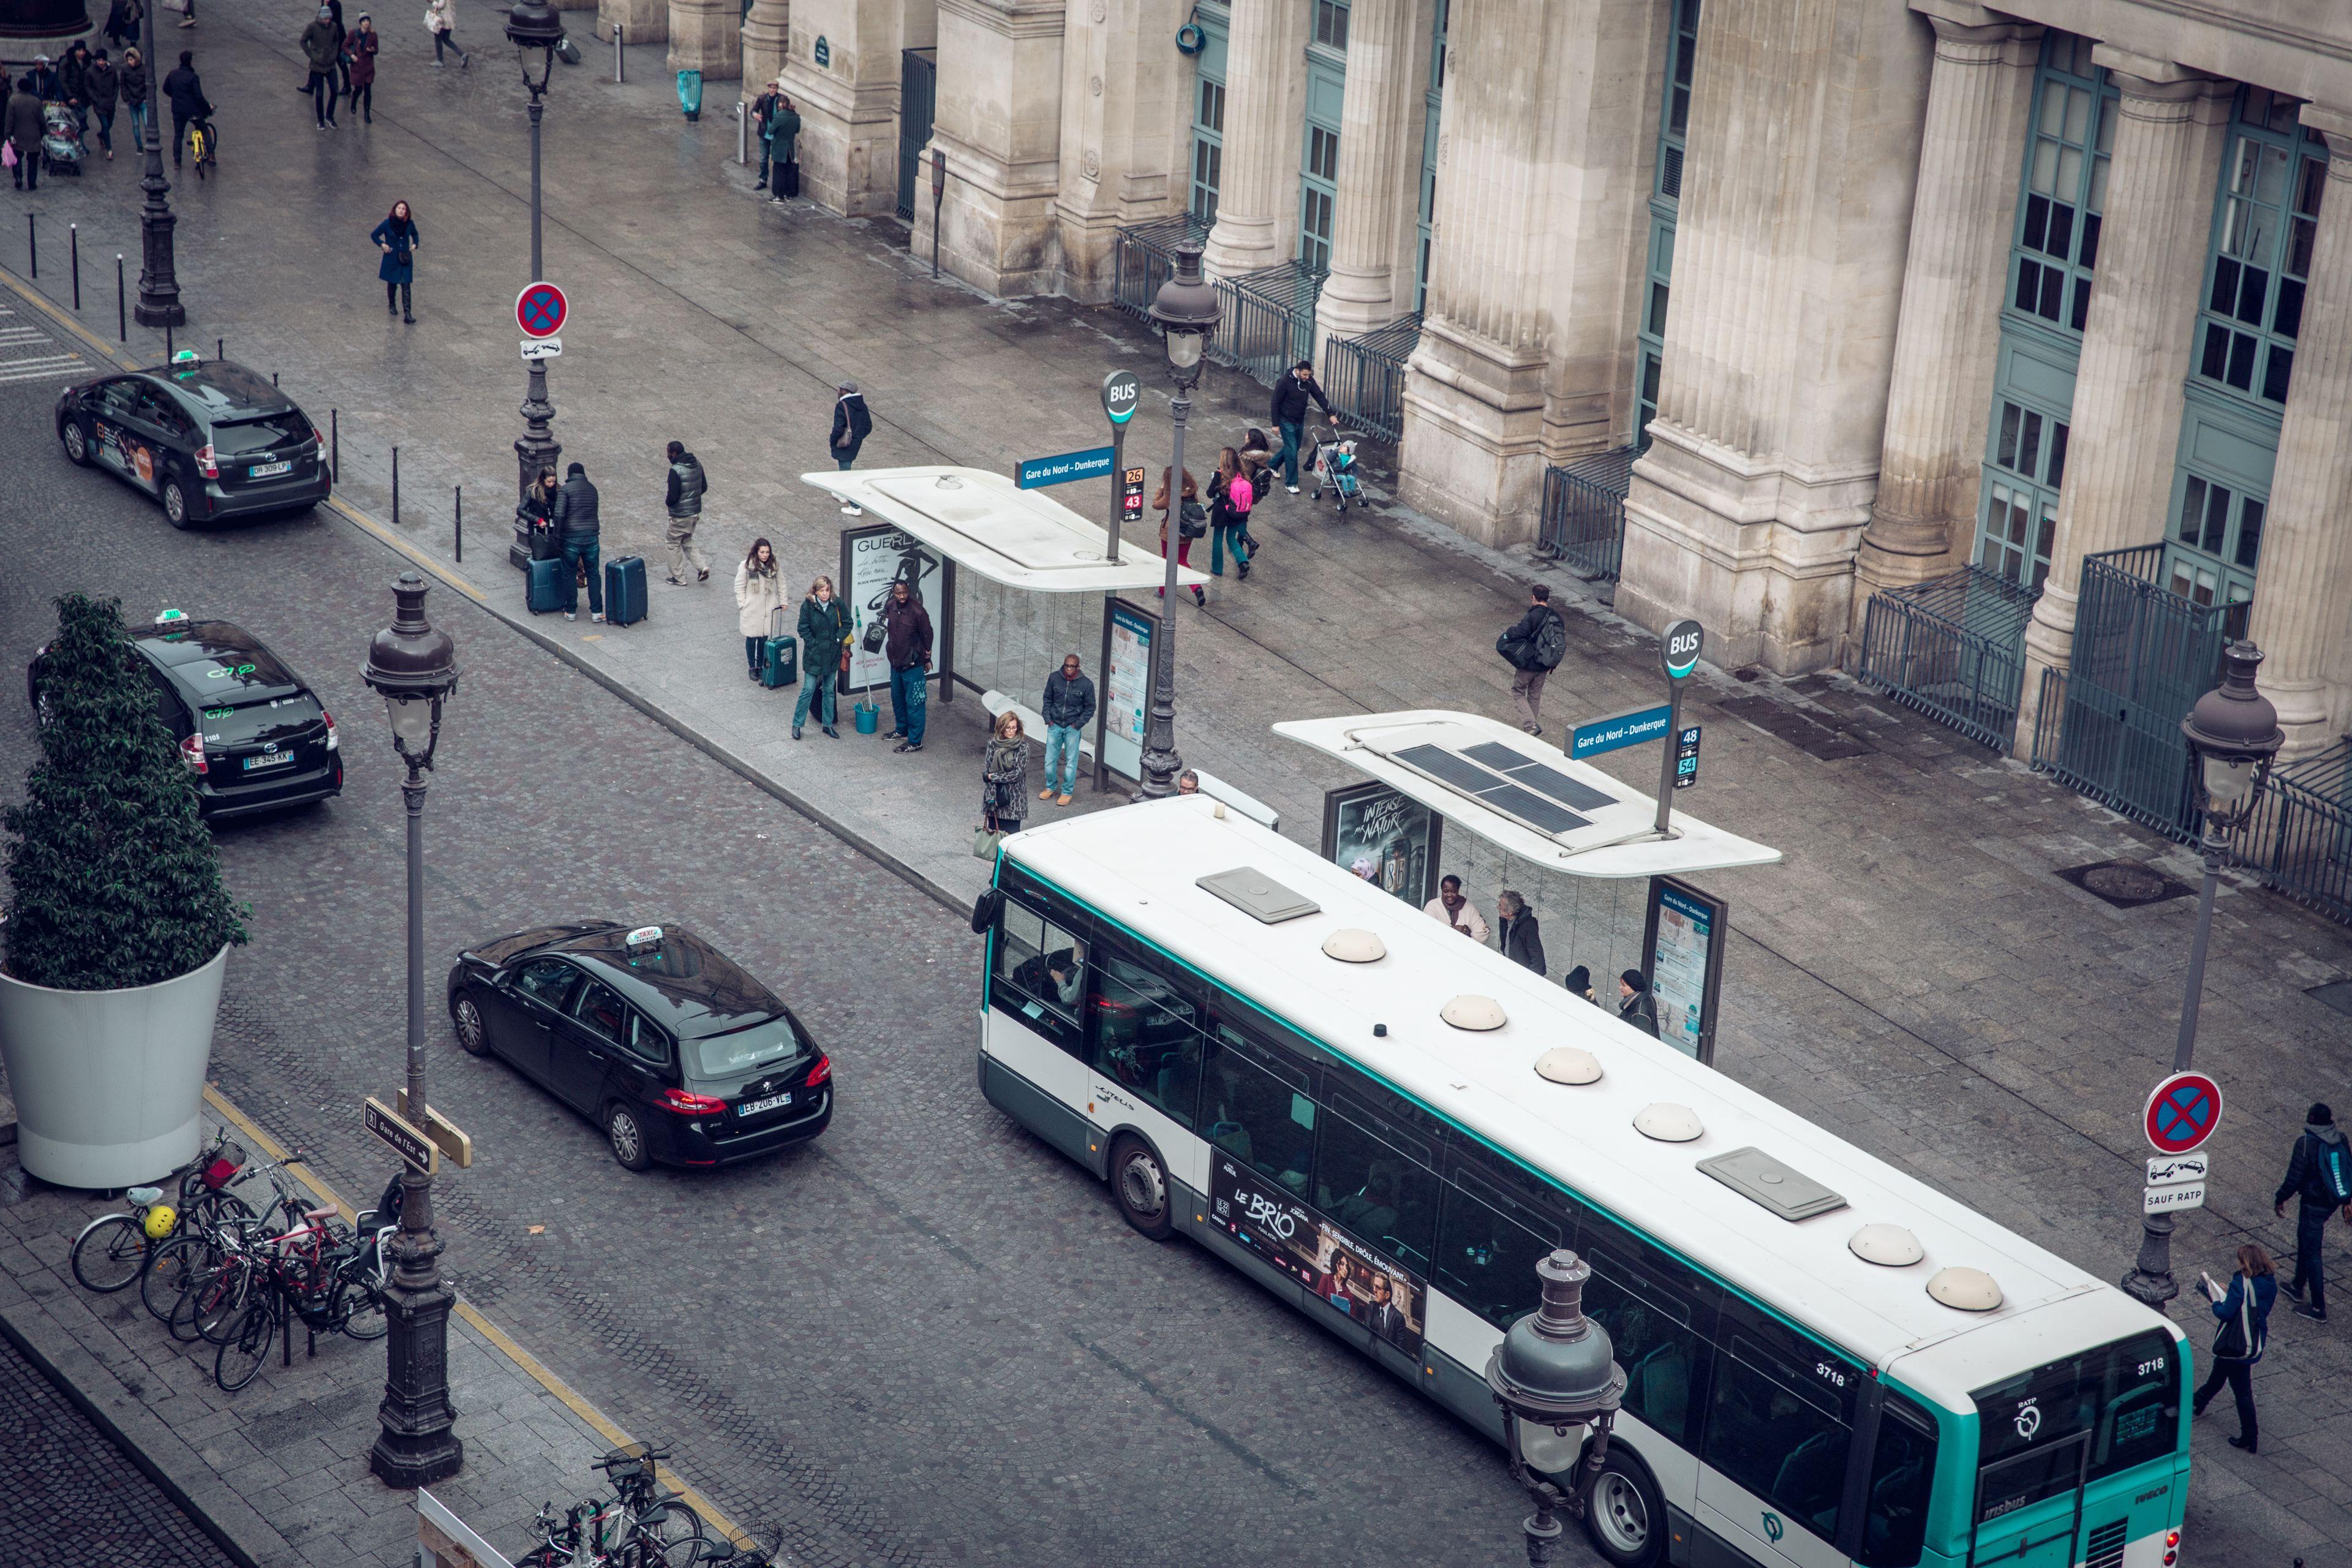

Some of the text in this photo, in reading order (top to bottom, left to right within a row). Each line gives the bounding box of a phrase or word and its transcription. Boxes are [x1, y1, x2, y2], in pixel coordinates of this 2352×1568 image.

[1110, 383, 1136, 402] BUS
[1026, 469, 1041, 480] Gare
[1042, 467, 1051, 477] du
[1053, 464, 1069, 474] Nord
[1075, 458, 1110, 471] Dunkerque
[1128, 470, 1140, 481] 26
[1126, 496, 1140, 508] 43
[1670, 632, 1698, 655] BUS
[1578, 737, 1594, 748] Gare
[1596, 733, 1604, 744] du
[1606, 728, 1623, 742] Nord
[1629, 718, 1666, 734] Dunkerque
[1683, 729, 1697, 743] 48
[249, 752, 287, 766] EE-345-KK
[1680, 759, 1694, 772] 54
[1362, 810, 1408, 844] NATURE
[1664, 894, 1673, 903] Gare
[1677, 900, 1687, 910] Nord
[1689, 906, 1708, 921] Dunkerque
[745, 1095, 785, 1112] EB-206-VL
[380, 1122, 416, 1155] Gare de l'Est
[1223, 1165, 1237, 1177] AUTEUIL
[1234, 1188, 1249, 1204] LE
[2147, 1191, 2201, 1205] SAUF RATP
[1290, 1207, 1309, 1223] JORDANA
[1332, 1229, 1355, 1251] SENSIBLE,
[1355, 1245, 1374, 1264] DRÔLE,
[1816, 1363, 1844, 1387] 3718
[2138, 1357, 2165, 1376] 3718
[2018, 1397, 2037, 1409] RATP
[2135, 1485, 2168, 1505] IVECO
